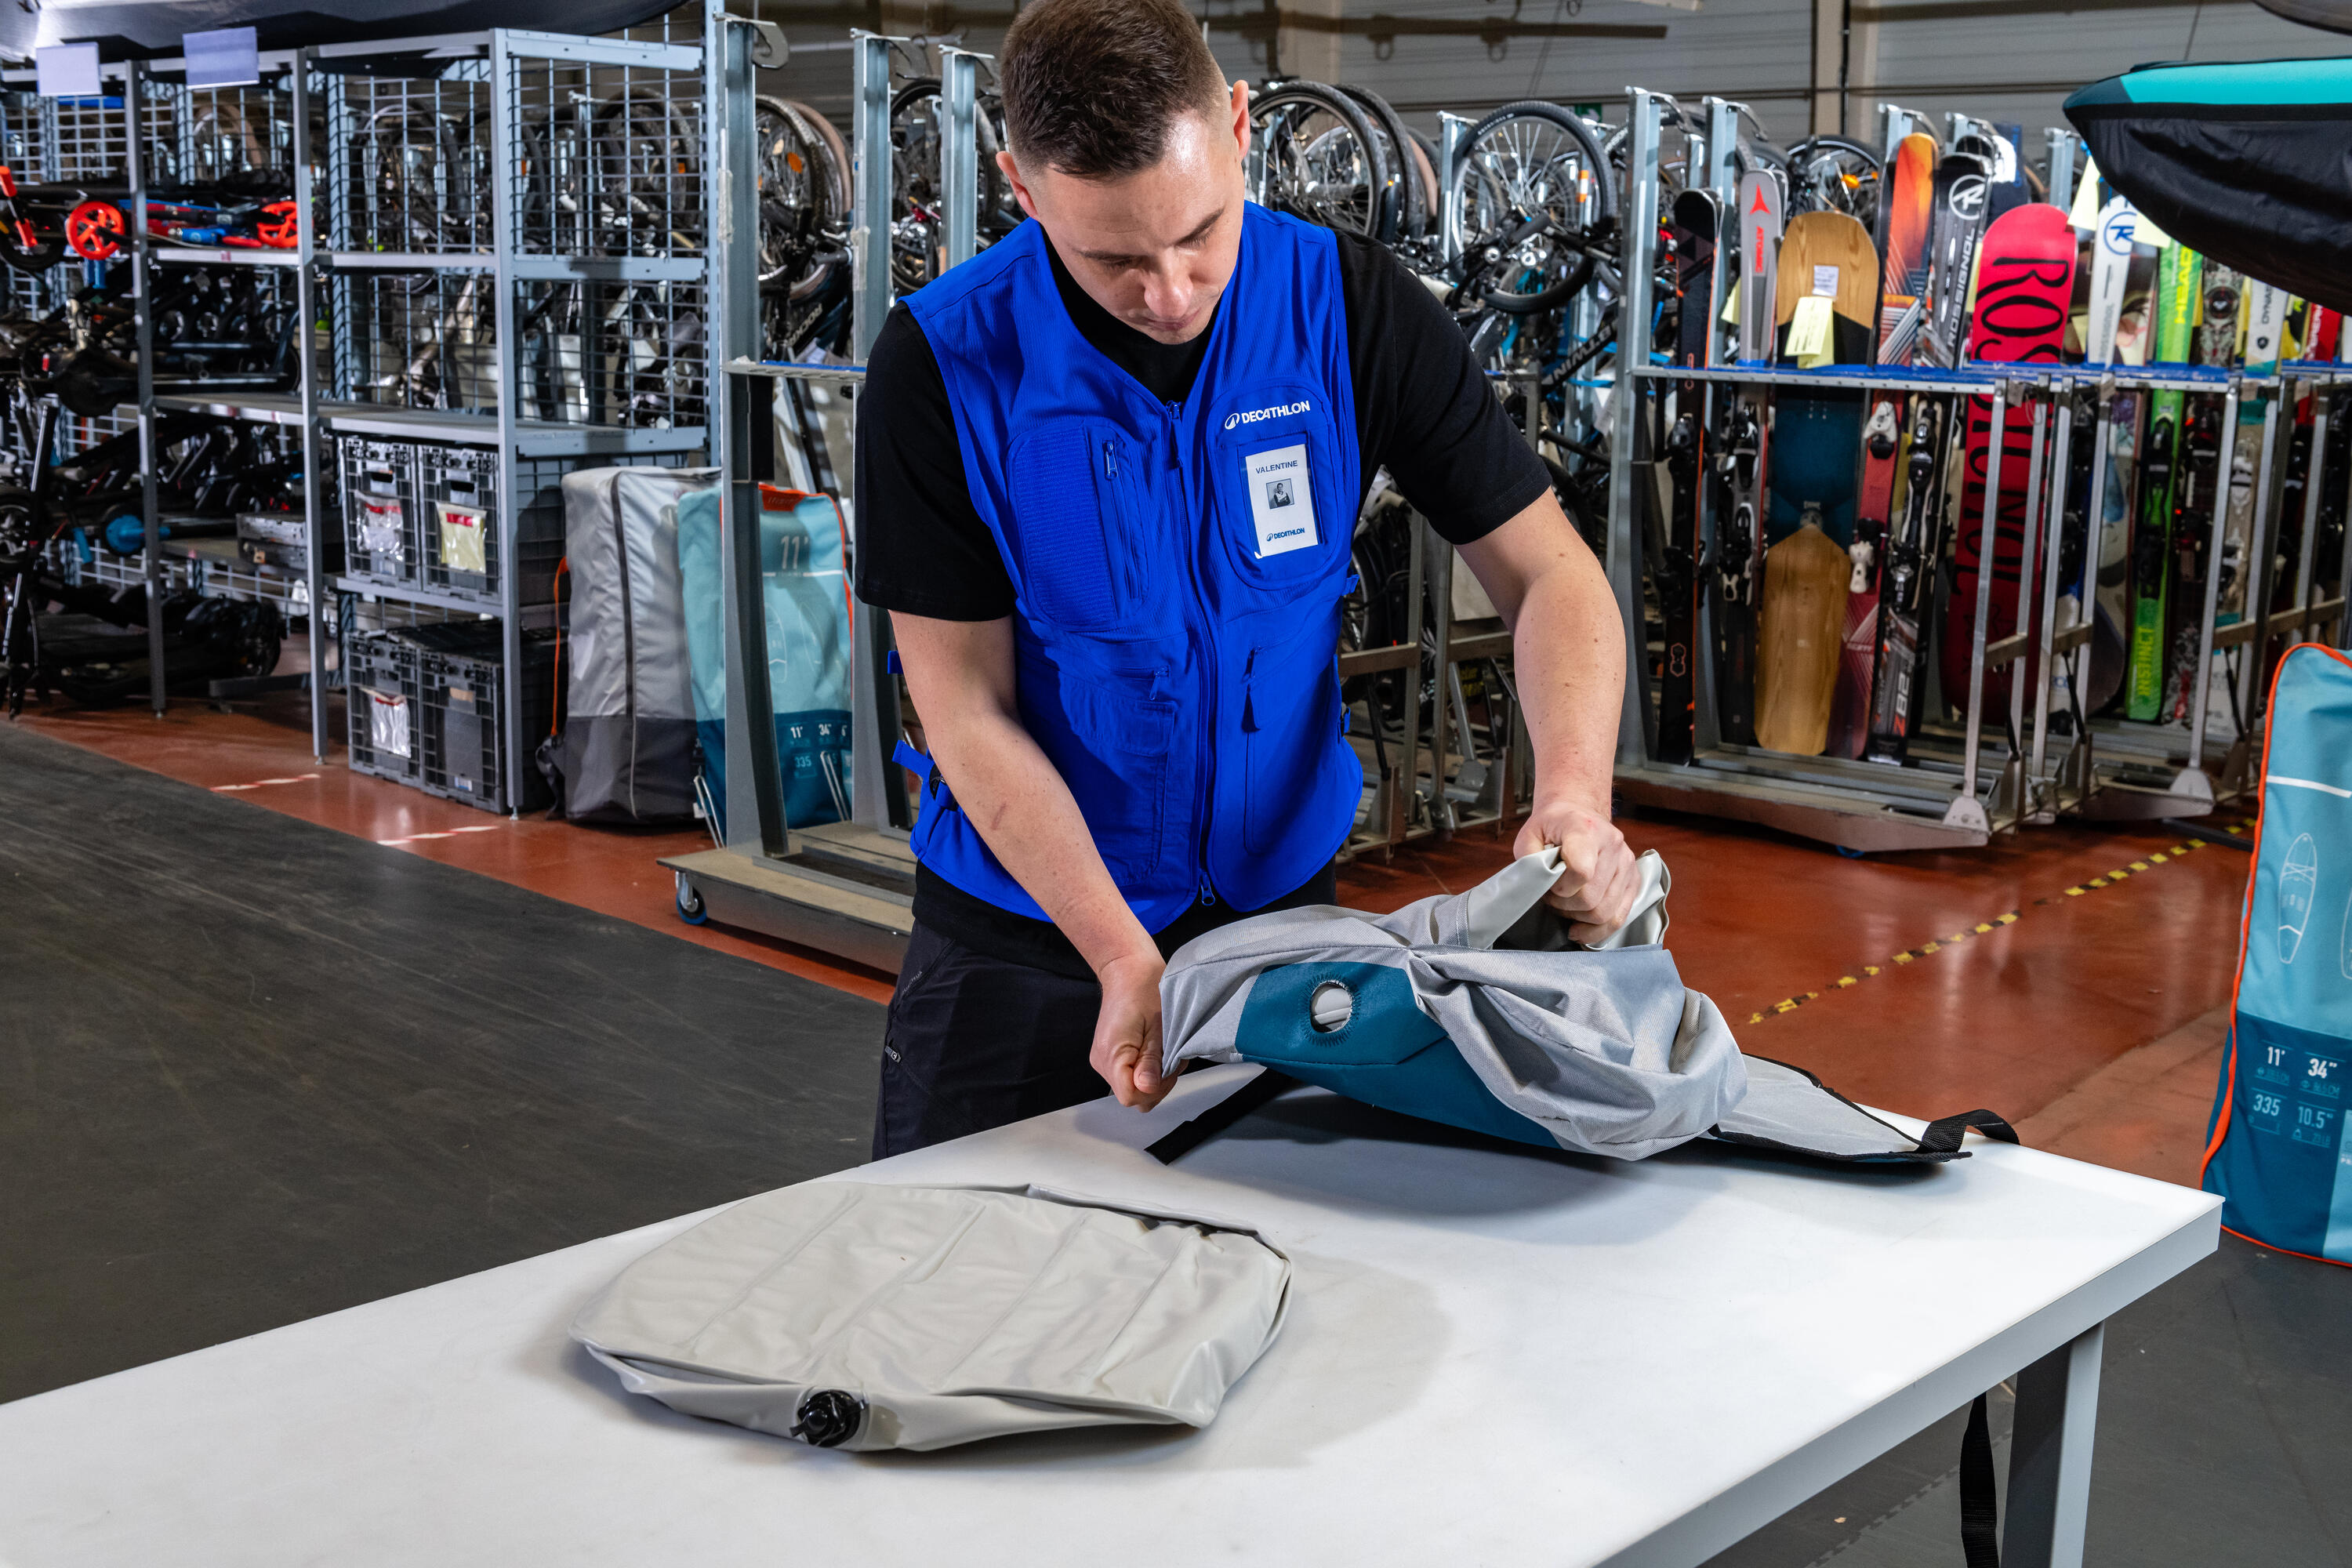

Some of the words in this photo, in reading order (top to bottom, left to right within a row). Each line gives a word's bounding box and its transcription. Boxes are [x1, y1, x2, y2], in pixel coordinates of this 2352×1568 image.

[1755, 227, 1764, 274] ATOMIC
[1947, 227, 1975, 348] ROSSIGNOL
[2174, 245, 2193, 325] HEAD
[1241, 400, 1311, 424] DECATHLON
[1255, 460, 1298, 474] VALENTINE
[1273, 528, 1305, 539] DECATHLON
[2137, 626, 2154, 696] INSTINCT
[1894, 672, 1910, 738] Z82
[2253, 1094, 2281, 1116] 335
